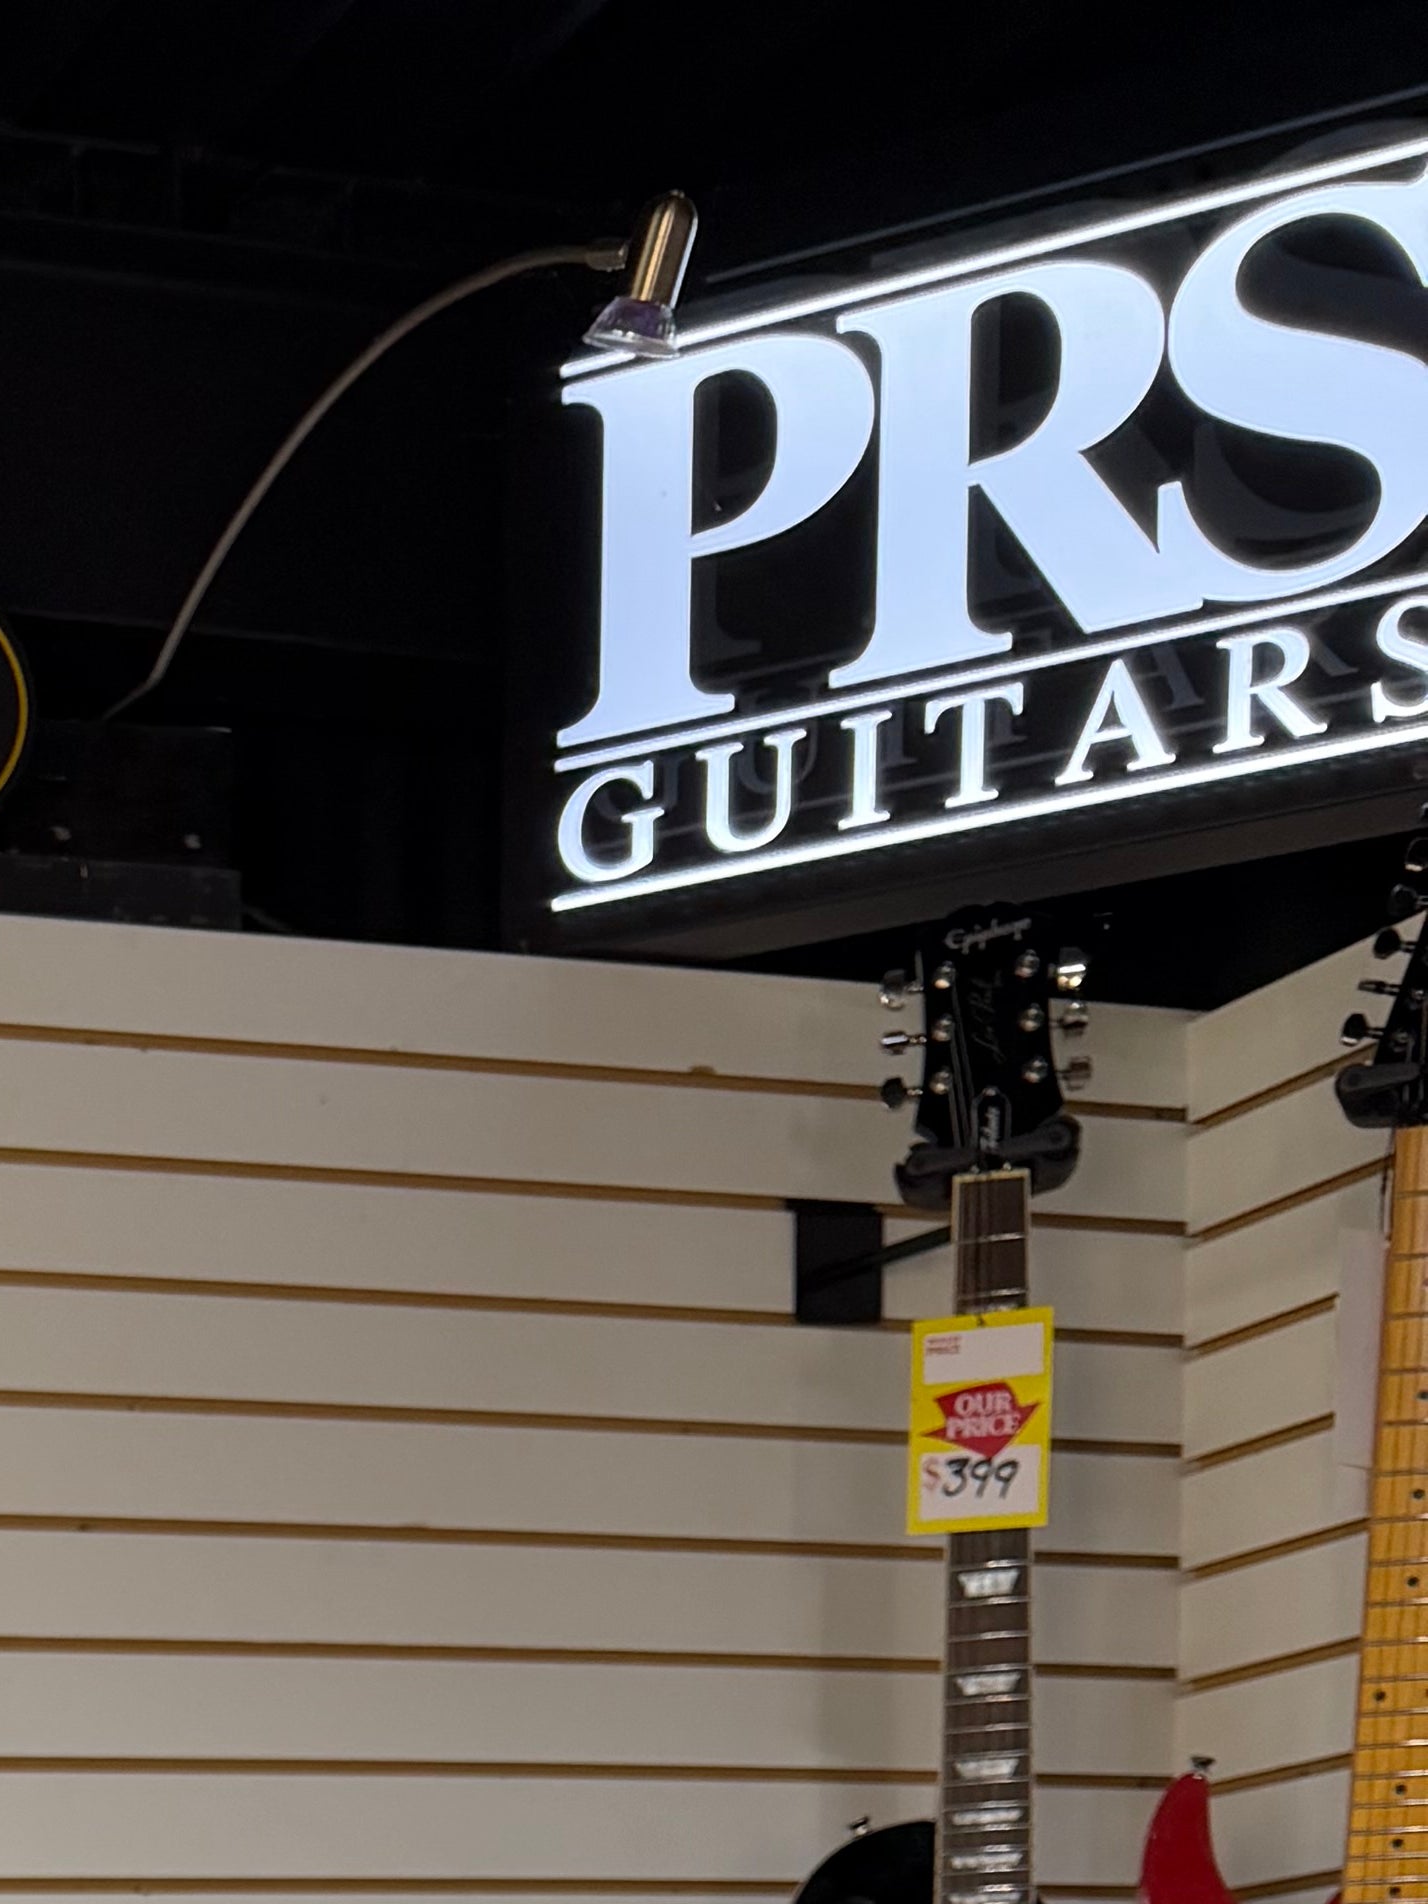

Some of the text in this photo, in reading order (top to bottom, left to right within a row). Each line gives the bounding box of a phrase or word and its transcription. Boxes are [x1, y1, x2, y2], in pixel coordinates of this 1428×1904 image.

[556, 180, 1428, 749] PRS
[557, 598, 1428, 882] GUITARS
[953, 1389, 1012, 1417] OUR
[945, 1411, 1022, 1440] PRICE
[923, 1457, 1020, 1499] $399
